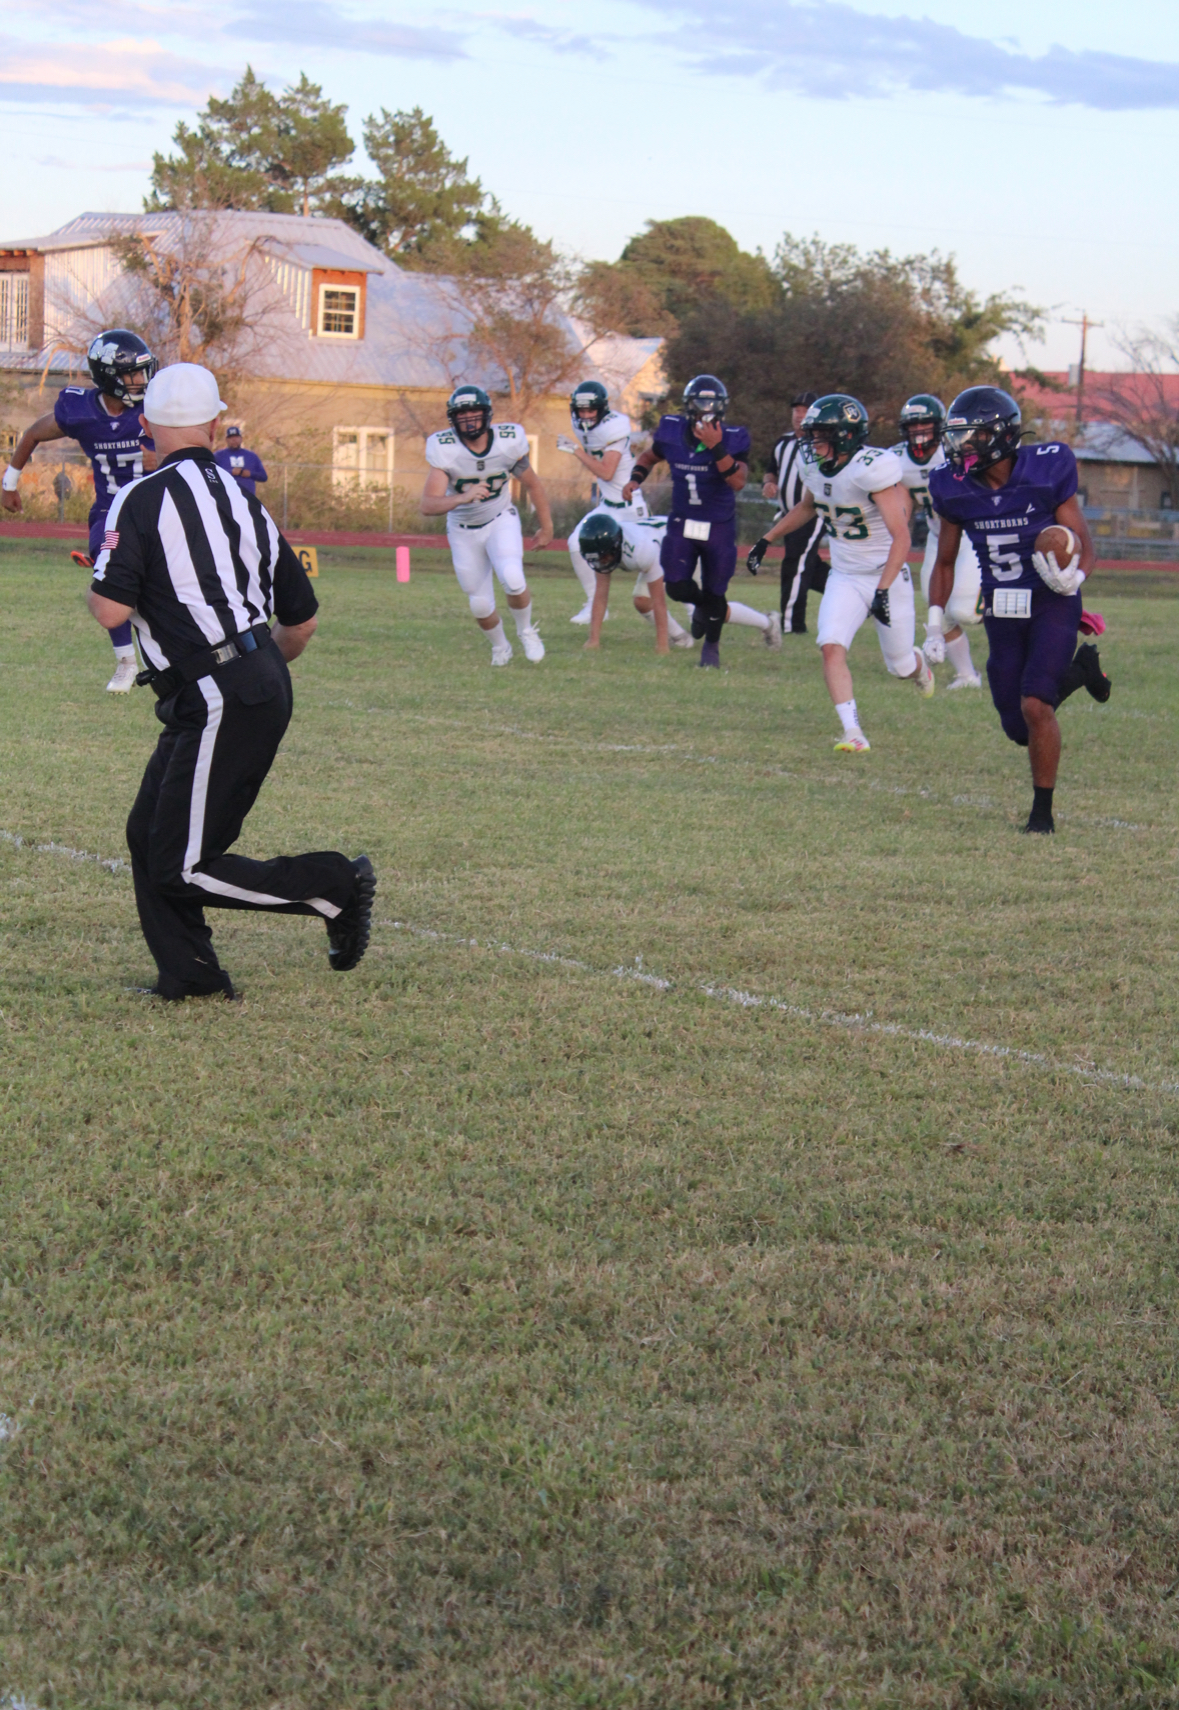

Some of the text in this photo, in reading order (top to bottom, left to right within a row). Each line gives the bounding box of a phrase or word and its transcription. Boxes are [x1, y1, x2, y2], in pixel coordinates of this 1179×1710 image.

[94, 439, 140, 450] SHORTHORNS
[1036, 445, 1060, 456] 5
[94, 451, 144, 495] 17
[674, 462, 709, 472] SHORTHORNS
[684, 473, 702, 506] 1
[813, 501, 870, 541] 33
[974, 517, 1029, 530] SHORTHORNS
[298, 550, 313, 573] G
[986, 533, 1024, 582] 5
